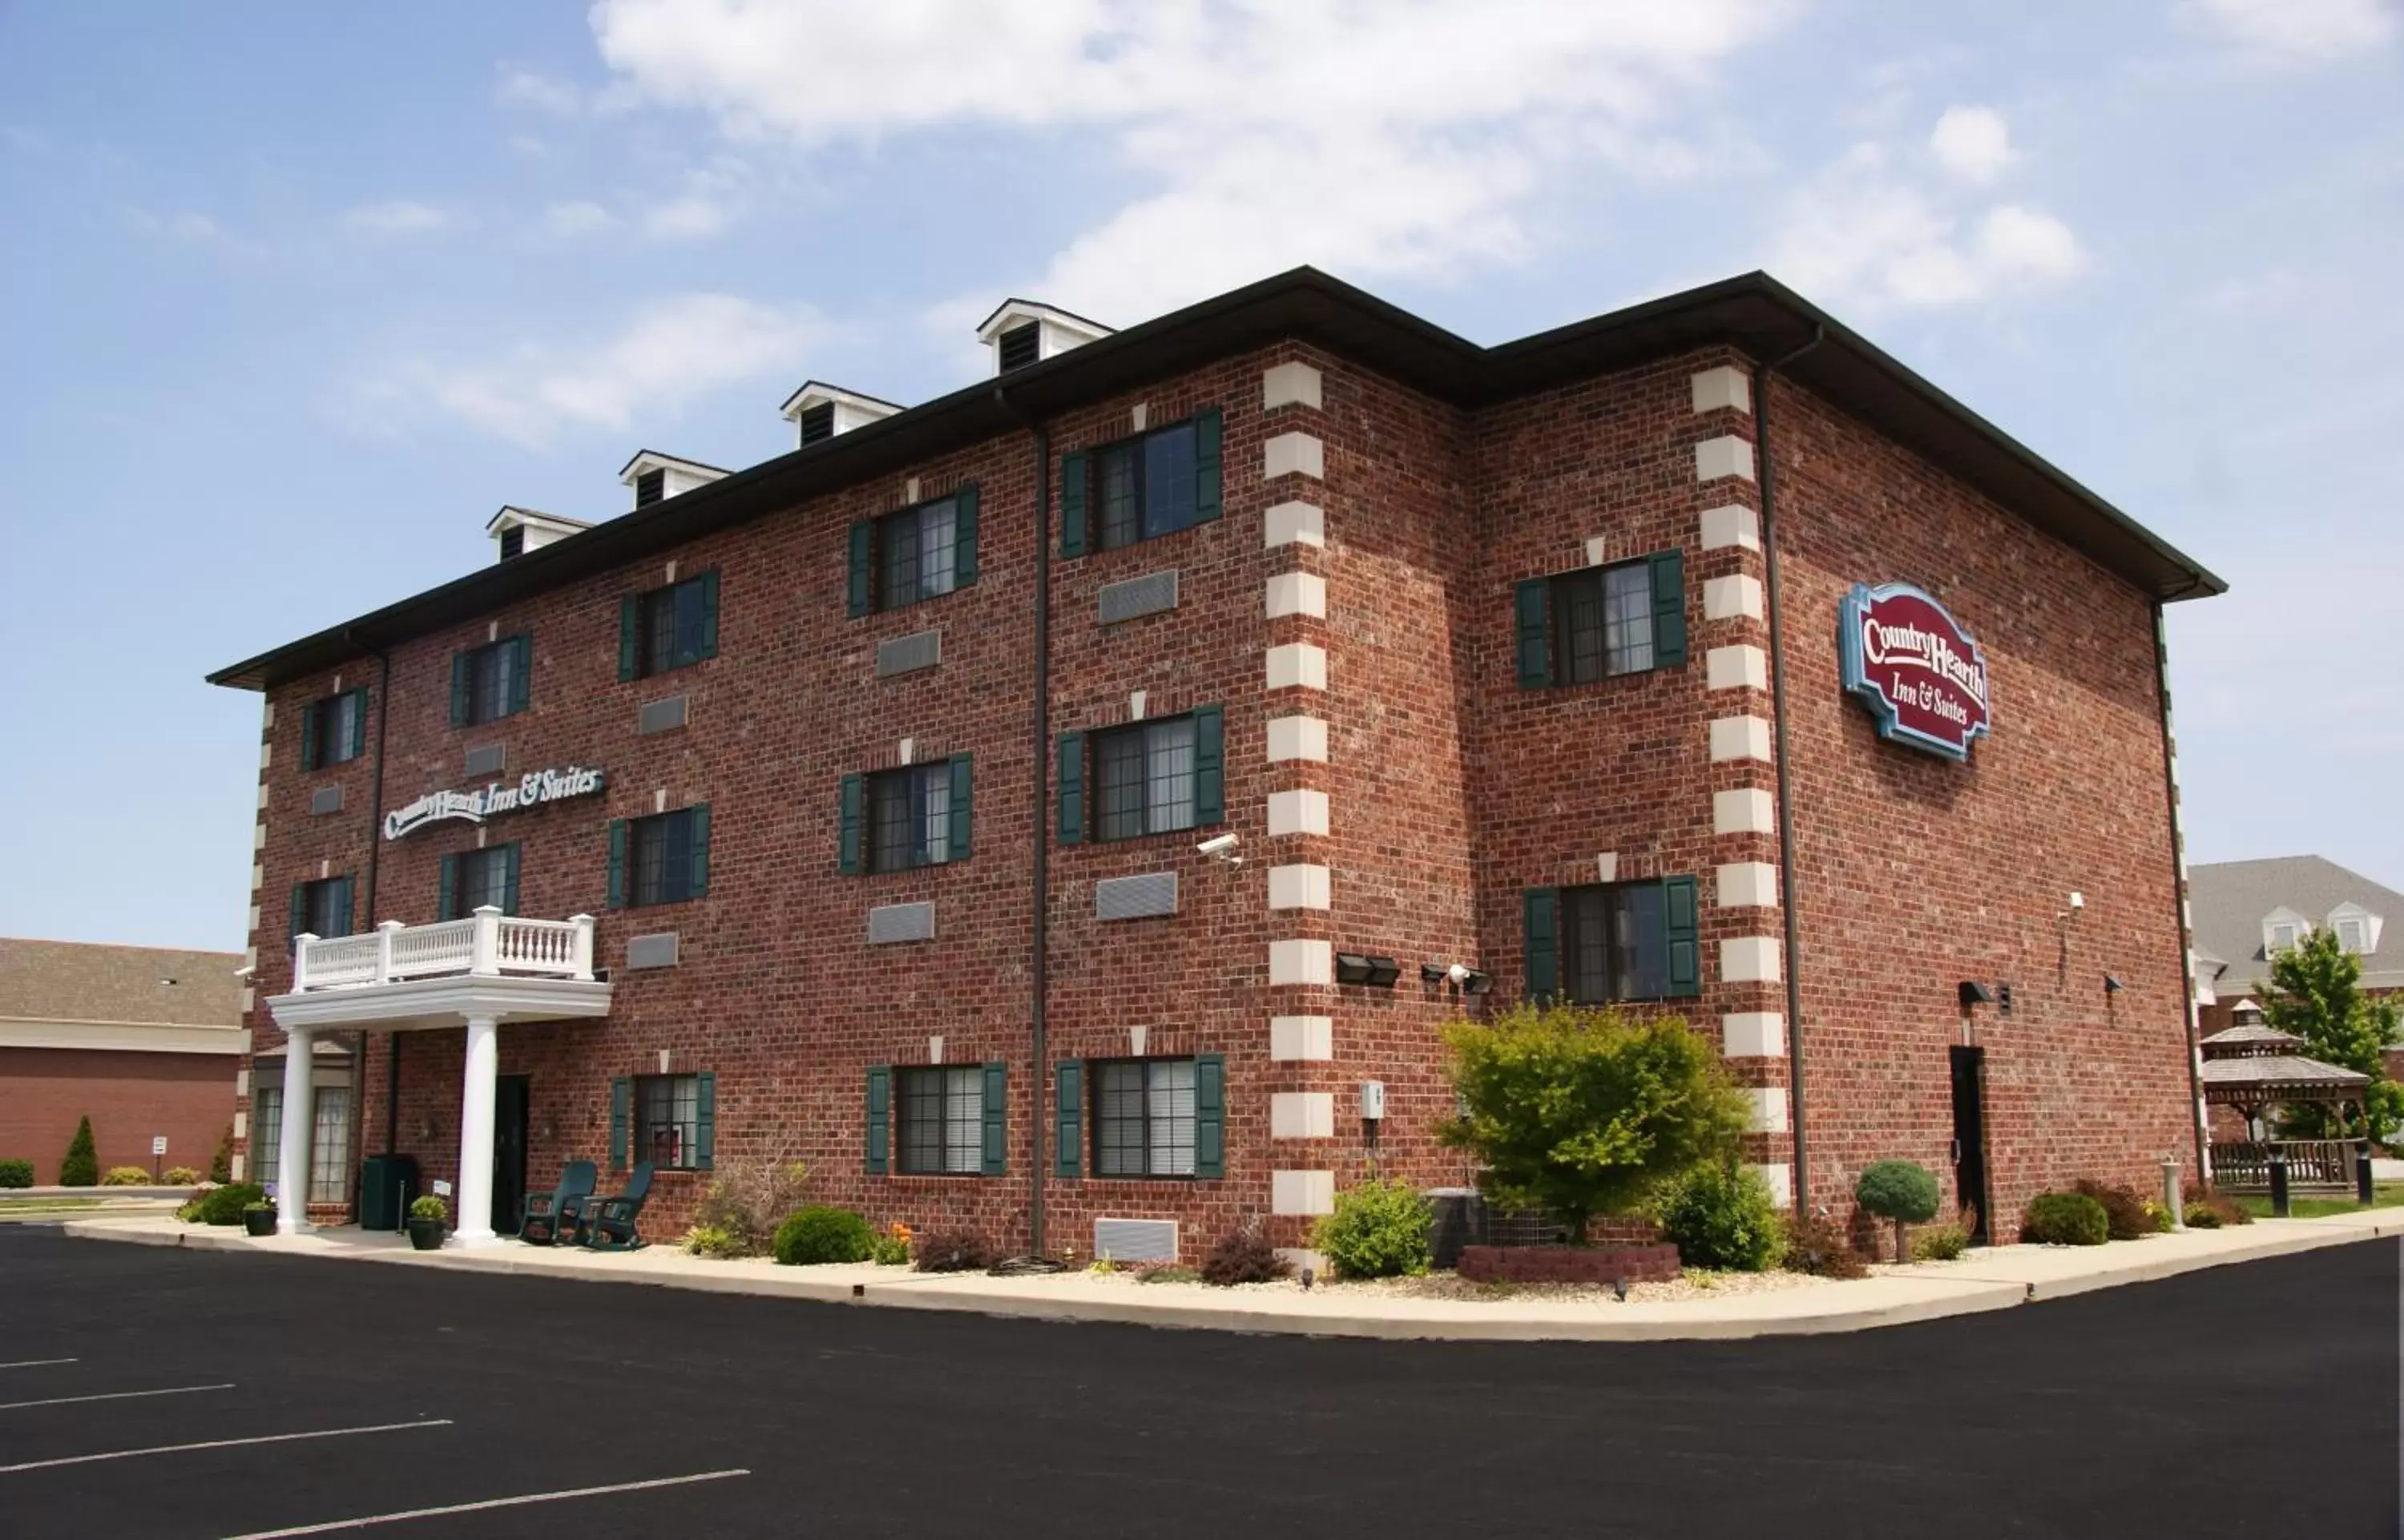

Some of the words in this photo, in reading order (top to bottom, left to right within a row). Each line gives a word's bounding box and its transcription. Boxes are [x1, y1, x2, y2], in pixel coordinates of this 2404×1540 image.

[1892, 671, 1917, 706] Inn
[1919, 680, 1933, 711] &
[1934, 687, 1967, 725] Suites
[483, 782, 518, 815] Inn
[519, 770, 543, 805] &
[539, 765, 599, 801] Suites
